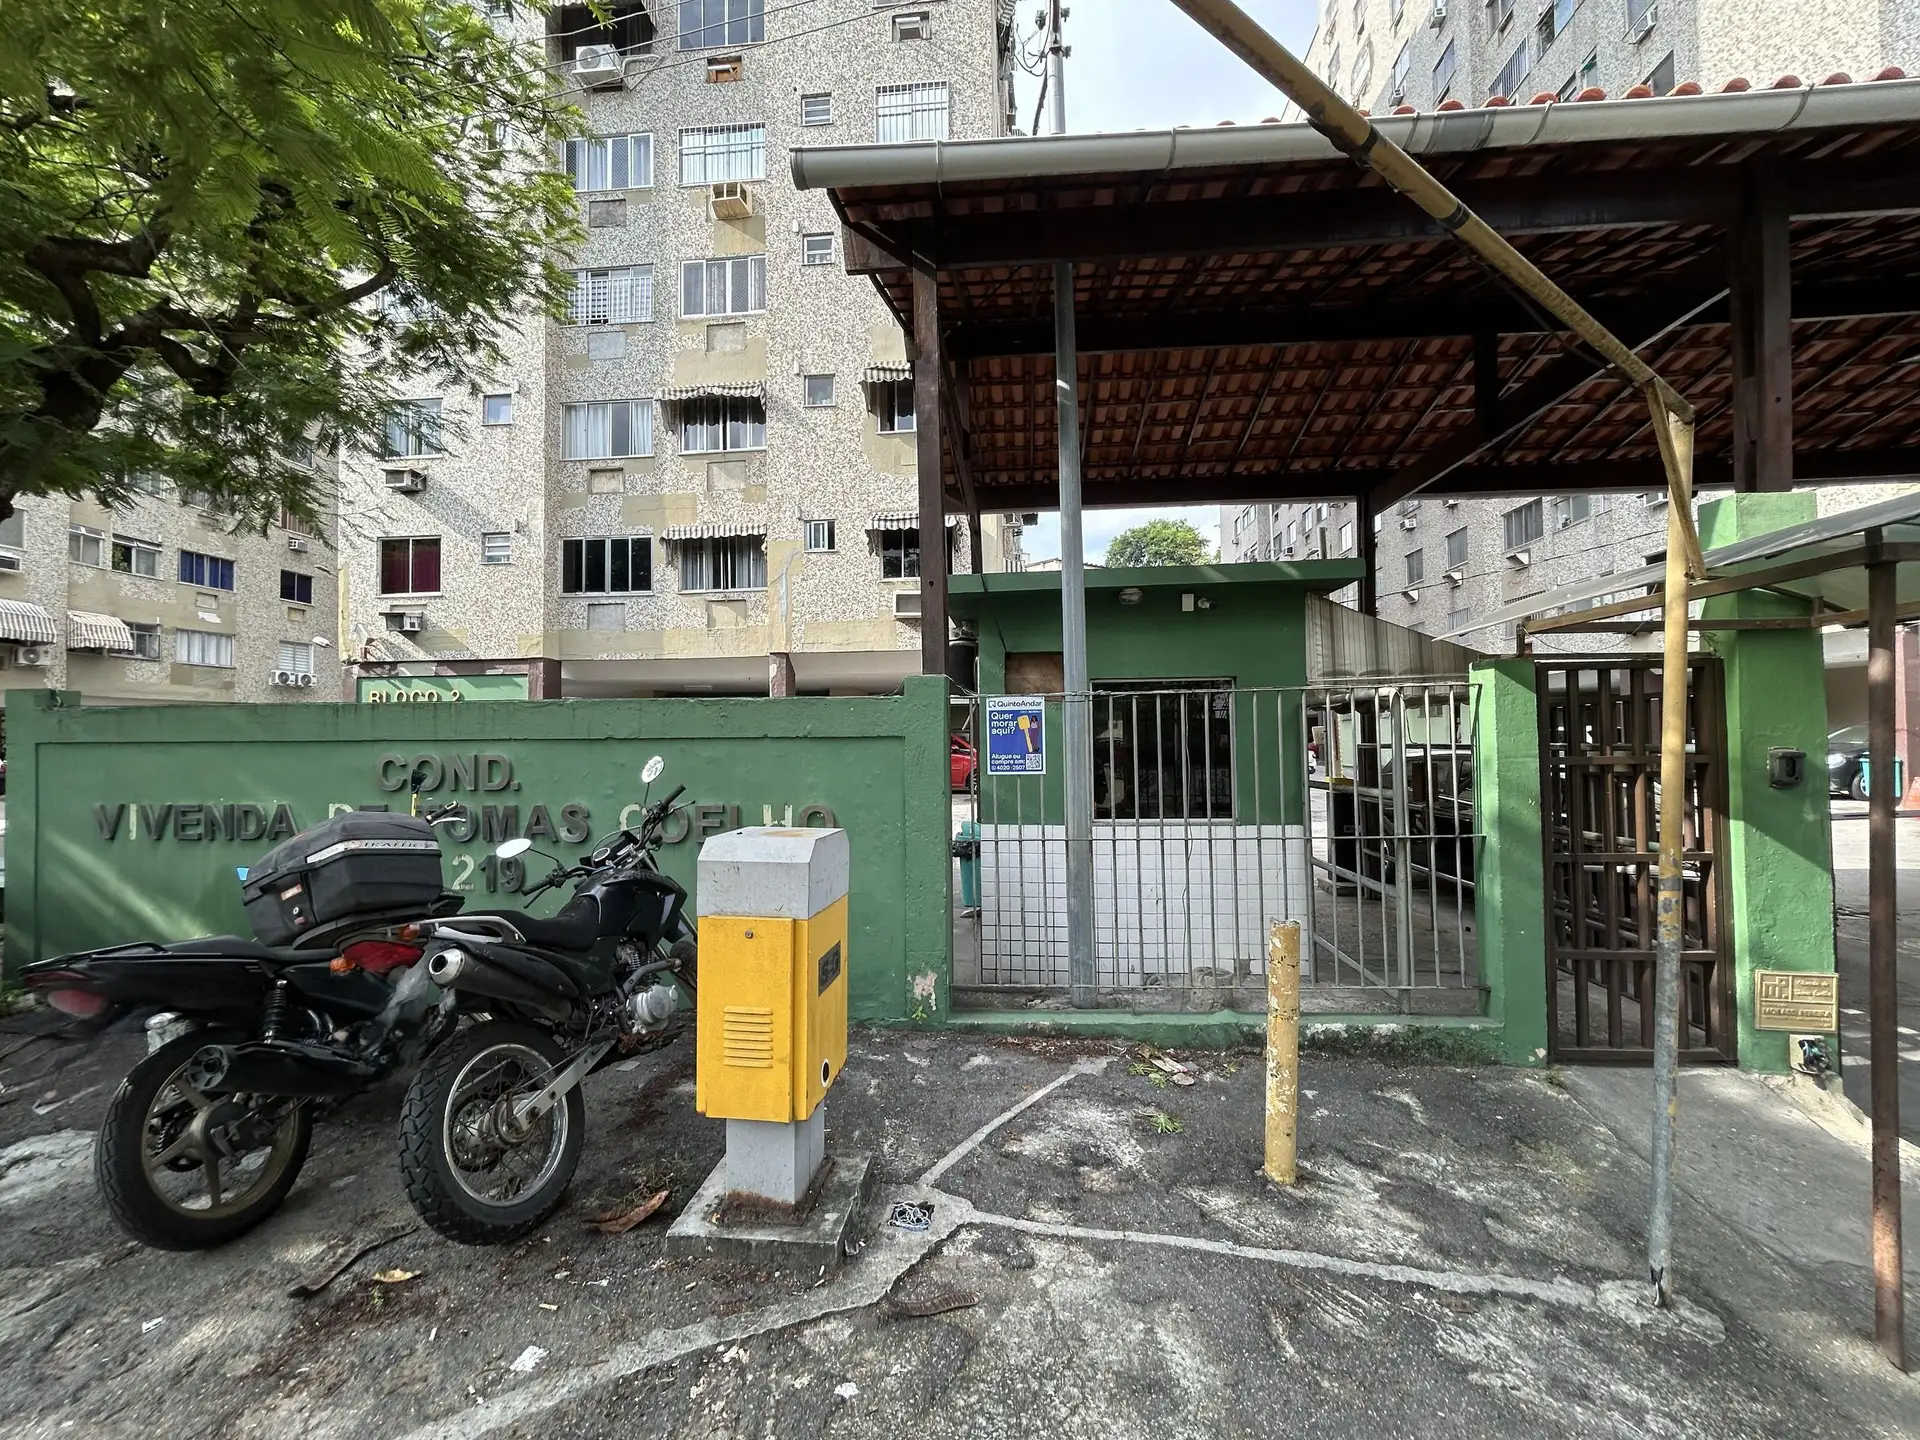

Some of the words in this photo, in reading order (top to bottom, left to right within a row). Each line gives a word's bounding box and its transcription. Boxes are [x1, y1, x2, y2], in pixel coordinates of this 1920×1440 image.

[449, 689, 460, 702] 2
[991, 712, 1013, 720] Quer
[991, 727, 1015, 736] aqui?
[379, 753, 522, 792] COND.
[93, 802, 300, 843] VIVENDA
[451, 853, 526, 893] 219
